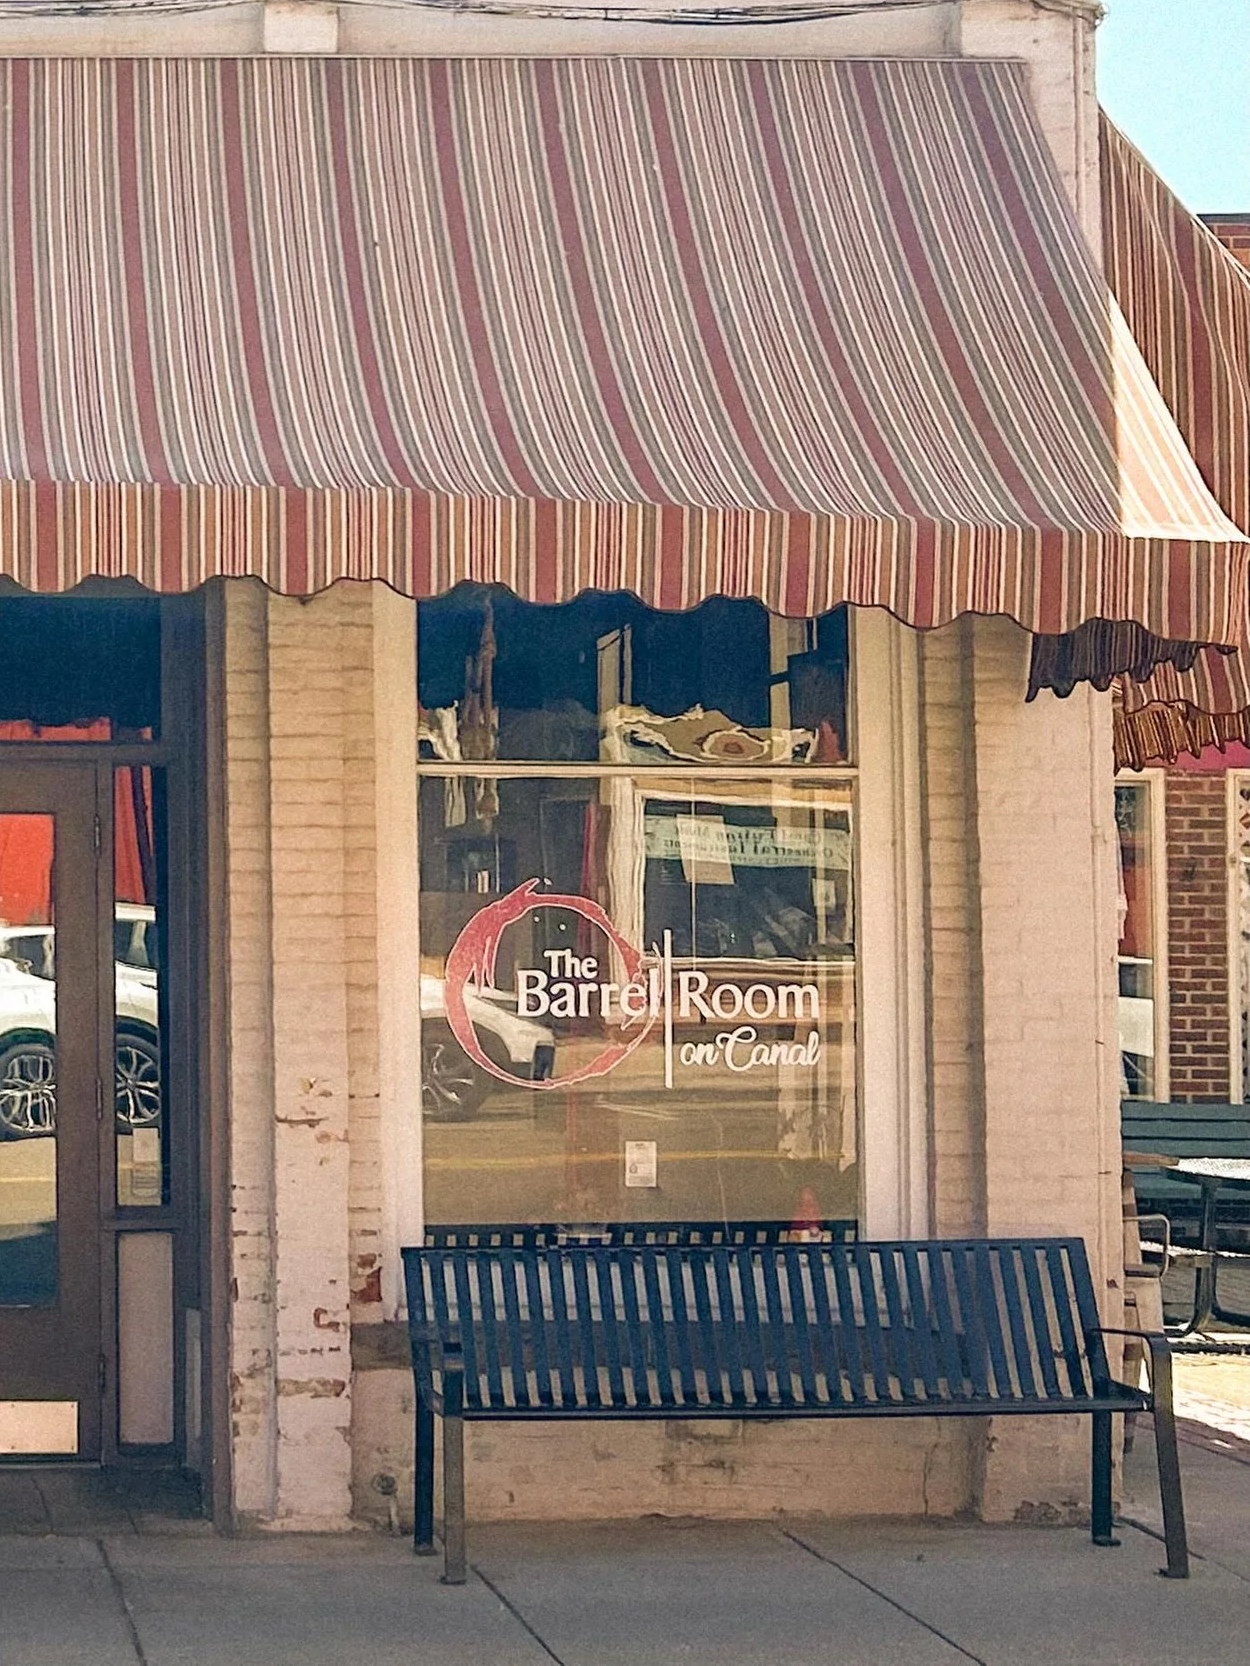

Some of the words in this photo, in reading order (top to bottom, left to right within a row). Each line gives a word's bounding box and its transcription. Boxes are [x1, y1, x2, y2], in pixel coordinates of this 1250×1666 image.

[543, 948, 599, 979] The
[517, 967, 660, 1018] Barrel
[678, 970, 820, 1019] Room
[679, 1040, 718, 1067] on
[716, 1026, 821, 1072] Canal
